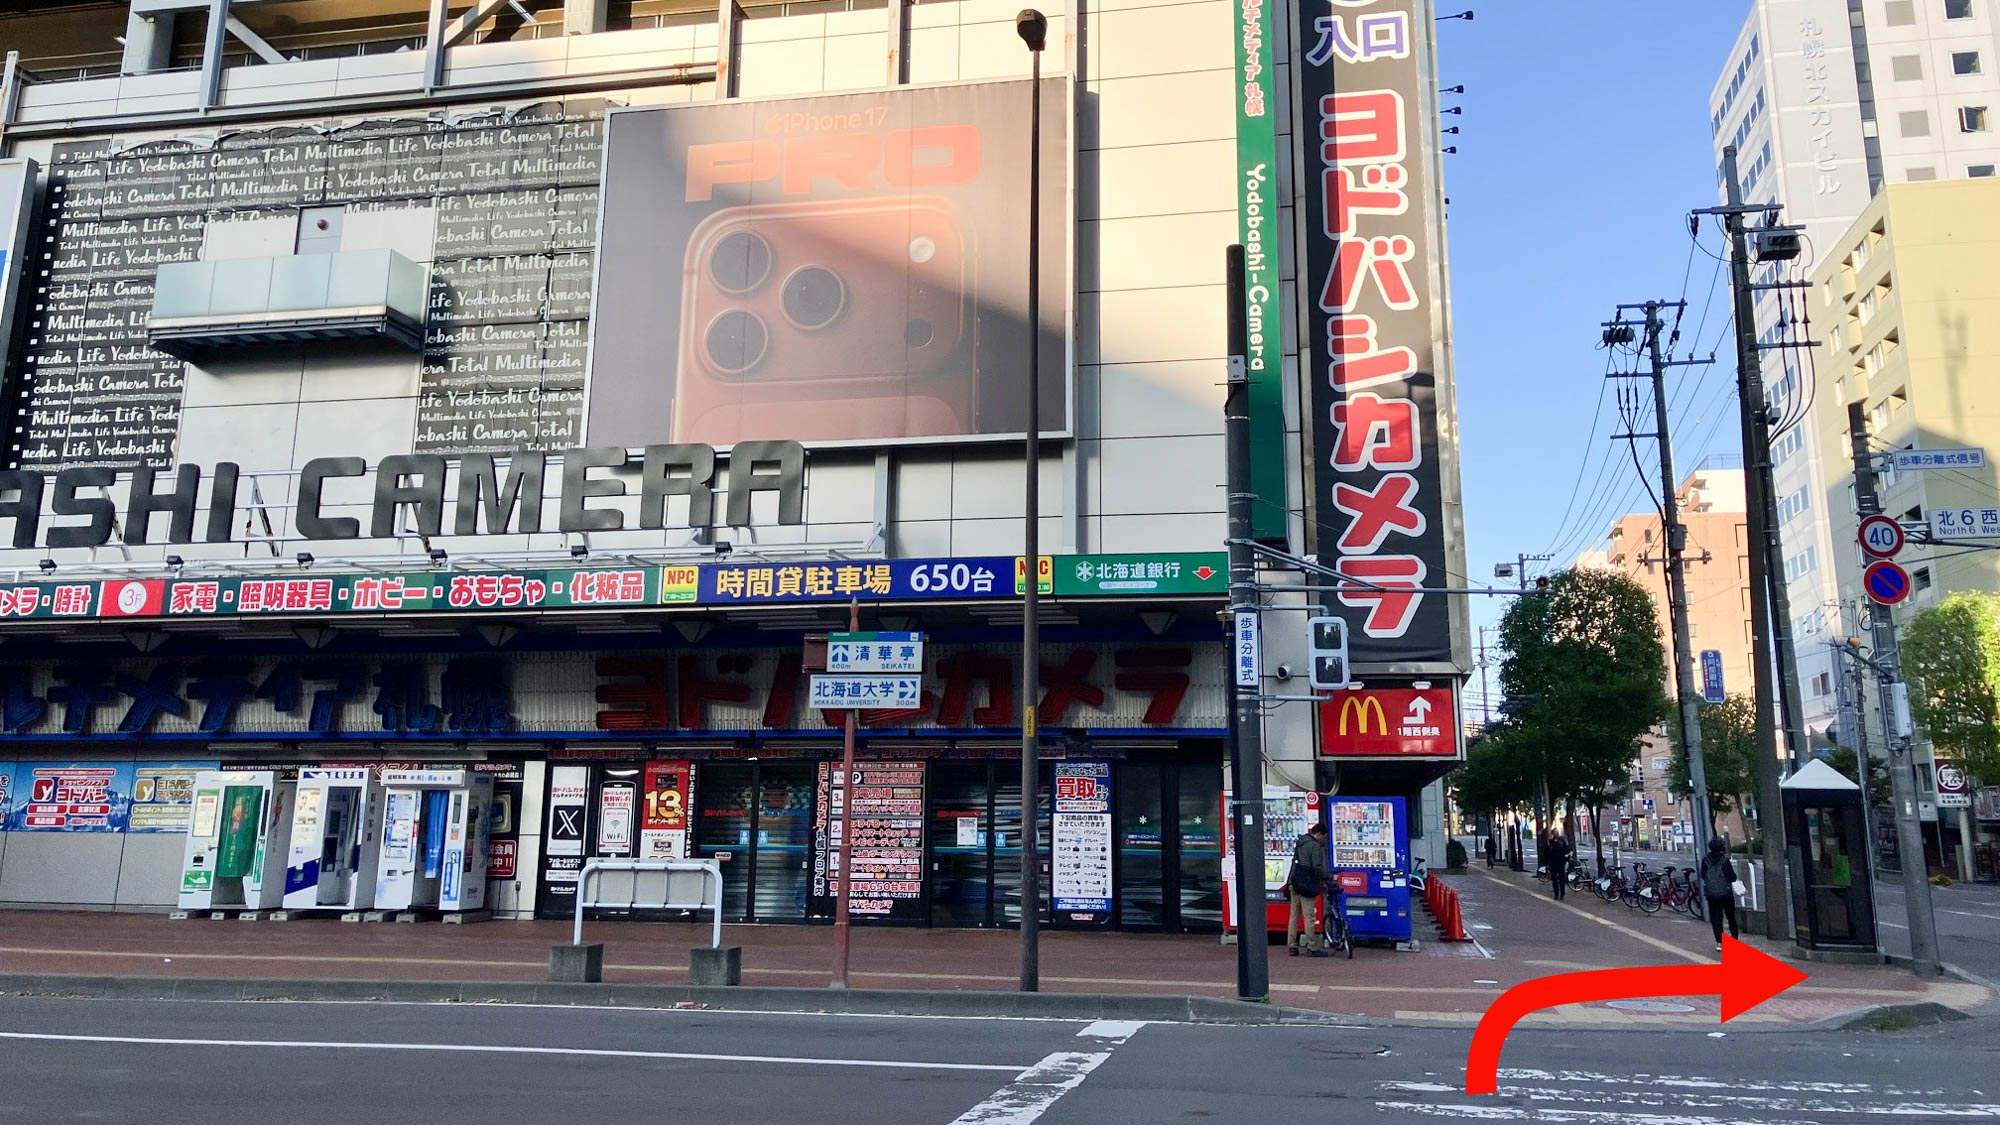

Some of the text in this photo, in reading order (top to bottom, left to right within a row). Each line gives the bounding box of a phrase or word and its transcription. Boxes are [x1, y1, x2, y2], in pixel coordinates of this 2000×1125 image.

[1306, 11, 1410, 66] 入口
[782, 105, 888, 131] iPhone 17
[107, 162, 134, 175] Life
[139, 156, 206, 172] Yodobashi
[210, 154, 258, 167] Camera
[262, 148, 298, 163] Total
[305, 140, 383, 160] Multimedia
[389, 139, 418, 152] Life
[423, 133, 493, 149] Yodobashi
[501, 129, 552, 144] Camera
[559, 124, 595, 138] Total
[686, 124, 981, 202] PRO
[63, 192, 122, 207] odobashi
[128, 188, 176, 203] Camera
[179, 184, 215, 199] Total
[221, 180, 298, 197] Multimedia
[304, 173, 333, 191] Life
[339, 169, 407, 187] Yodobashi
[413, 166, 464, 182] Camera
[467, 162, 506, 176] Total
[513, 158, 595, 174] Multimedia
[62, 186, 598, 237] Multimedia Life Yodobashi Camera
[491, 219, 587, 240] Camera Total
[92, 247, 193, 267] Life Yodobashi
[459, 255, 588, 274] Total Multimedia
[1246, 163, 1269, 371] Yodobashi-Camera
[49, 285, 108, 299] odobashi
[457, 287, 591, 306] Yodobashi Camera
[48, 314, 124, 330] Multimedia
[482, 322, 580, 341] Camera Total
[77, 349, 106, 363] Life
[449, 352, 581, 372] Total Multimedia
[1319, 88, 1427, 638] ヨドバシカメラ
[34, 376, 93, 394] odobashi
[99, 377, 149, 391] Camera
[447, 387, 584, 406] Yodobashi Camera
[32, 408, 109, 426] Multimedia
[115, 407, 144, 423] Life
[473, 420, 572, 440] Camera Total
[63, 439, 165, 457] Life Yodobashi
[1900, 453, 1981, 466] 歩車分離式信号
[296, 440, 805, 539] CAMERA
[1870, 528, 1894, 546] 40
[1939, 527, 1966, 535] North
[1969, 526, 1976, 534] 6
[1019, 560, 1048, 575] NC
[1096, 562, 1180, 579] 北海道銀行
[667, 570, 695, 585] NPC
[715, 563, 996, 599] 時間貸駐車場 650台
[124, 588, 142, 606] 3F
[856, 646, 915, 661] 清華亭
[1241, 617, 1253, 681] 歩車分離式
[815, 681, 894, 697] 北海道大学
[1057, 777, 1096, 799] 買取
